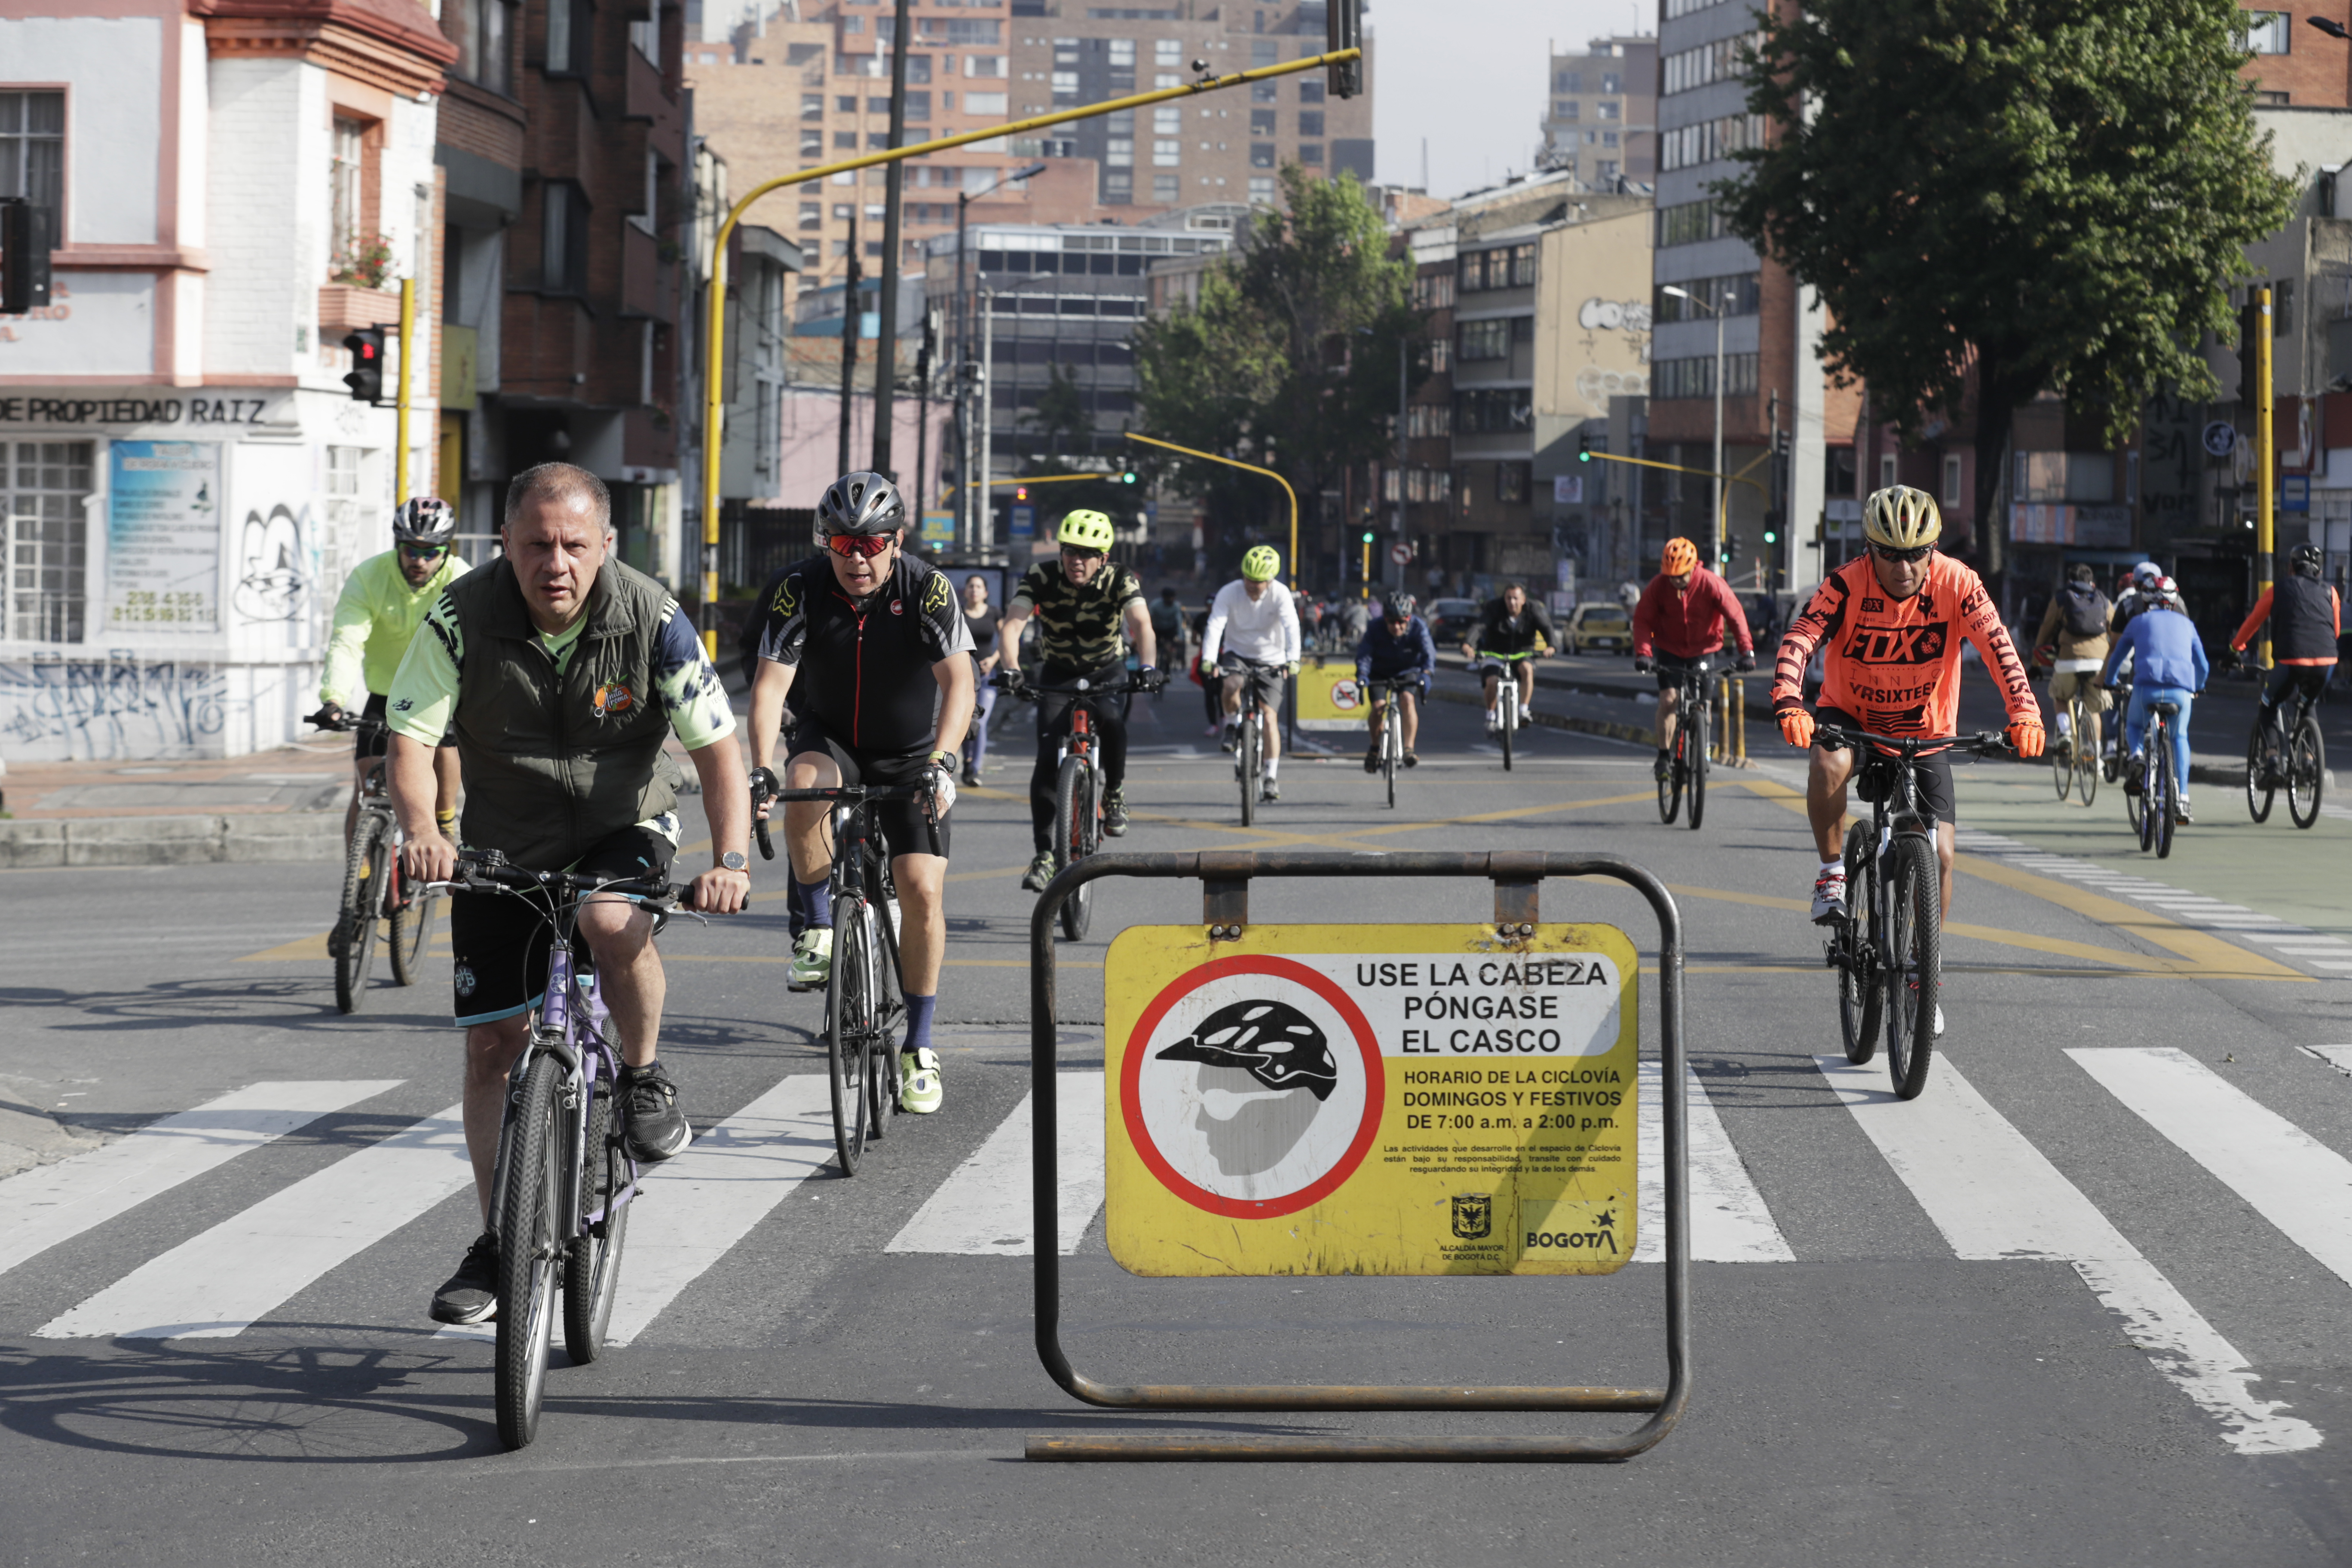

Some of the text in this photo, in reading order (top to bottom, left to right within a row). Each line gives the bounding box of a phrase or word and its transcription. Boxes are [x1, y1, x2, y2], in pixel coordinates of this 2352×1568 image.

[28, 399, 182, 423] PROPIEDAD
[191, 399, 266, 423] RAIZ
[1813, 612, 1828, 628] 74
[1844, 625, 1925, 662] FOX
[1357, 962, 1608, 986] USE LA CABEZA
[1405, 991, 1558, 1020] PÓNGASE
[1403, 1029, 1561, 1053] EL CASCO
[1405, 1067, 1620, 1084] HORARIO DE LA CICLOVÍA
[1404, 1092, 1622, 1106] DOMINGOS Y FESTIVOS
[1408, 1115, 1619, 1131] DE 7:00 a.m. a 2:00 p.m.
[1410, 1166, 1466, 1174] resguardando
[1481, 1166, 1522, 1174] integridad
